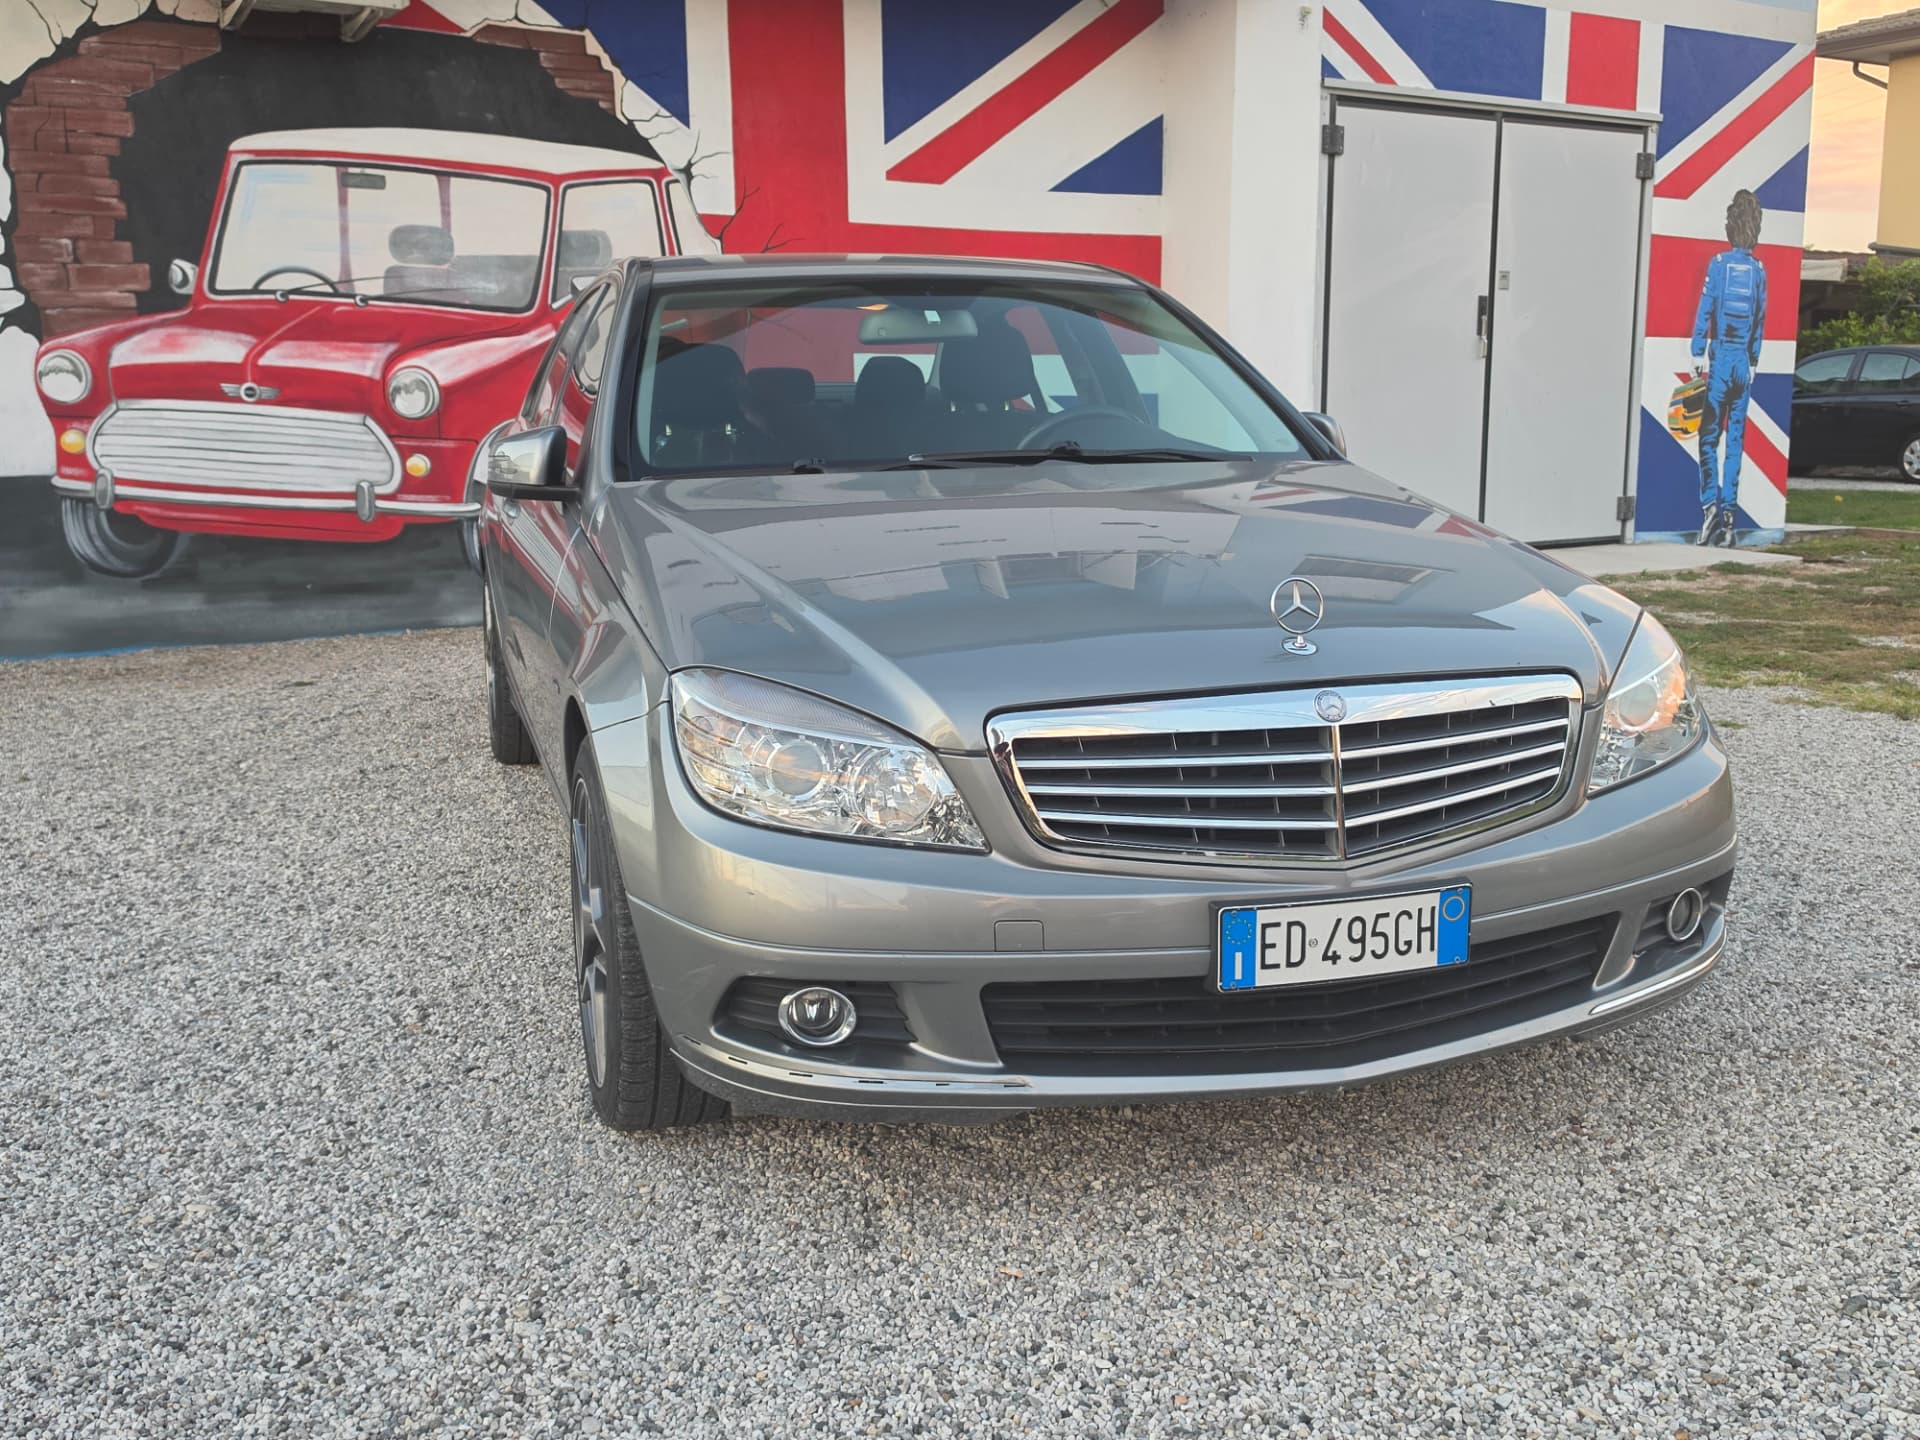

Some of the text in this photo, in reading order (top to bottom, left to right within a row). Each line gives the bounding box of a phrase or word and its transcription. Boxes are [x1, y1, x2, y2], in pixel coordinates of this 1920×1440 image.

[1260, 905, 1436, 970] ED 495GH
[1234, 951, 1243, 980] I
